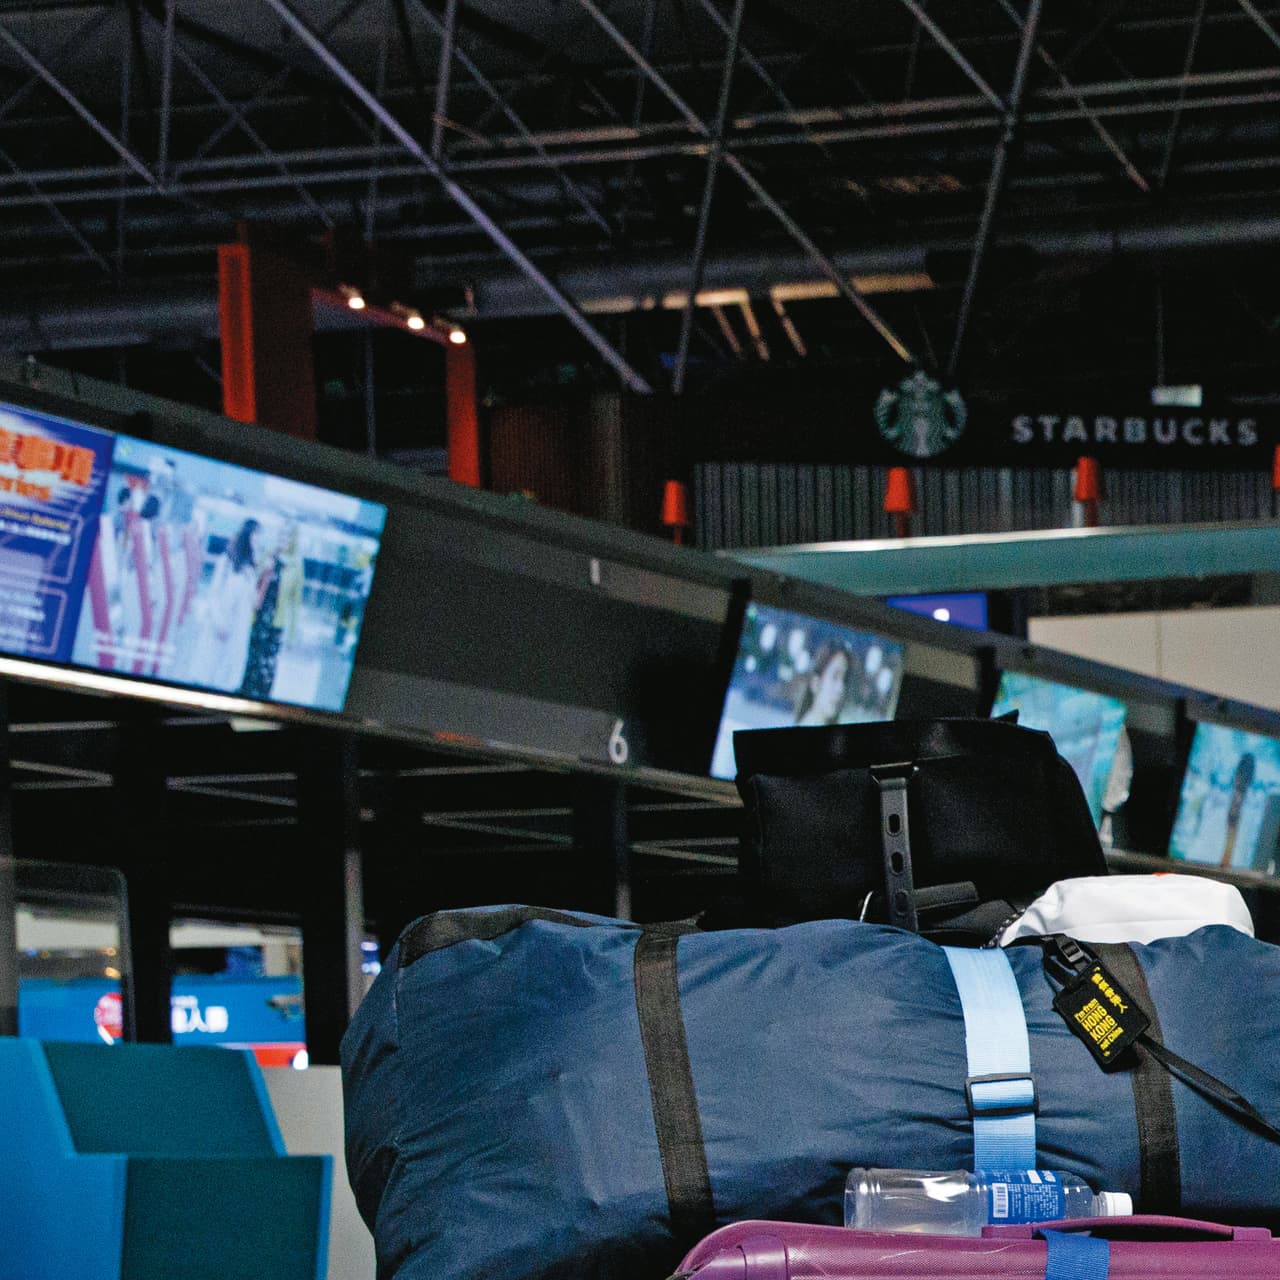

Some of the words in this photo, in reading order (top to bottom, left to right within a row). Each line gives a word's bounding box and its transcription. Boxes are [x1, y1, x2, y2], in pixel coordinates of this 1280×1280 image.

[1012, 414, 1258, 446] STARBUCKS
[608, 719, 629, 765] 6
[1082, 1005, 1108, 1032] HONG
[1089, 1014, 1117, 1041] KONG
